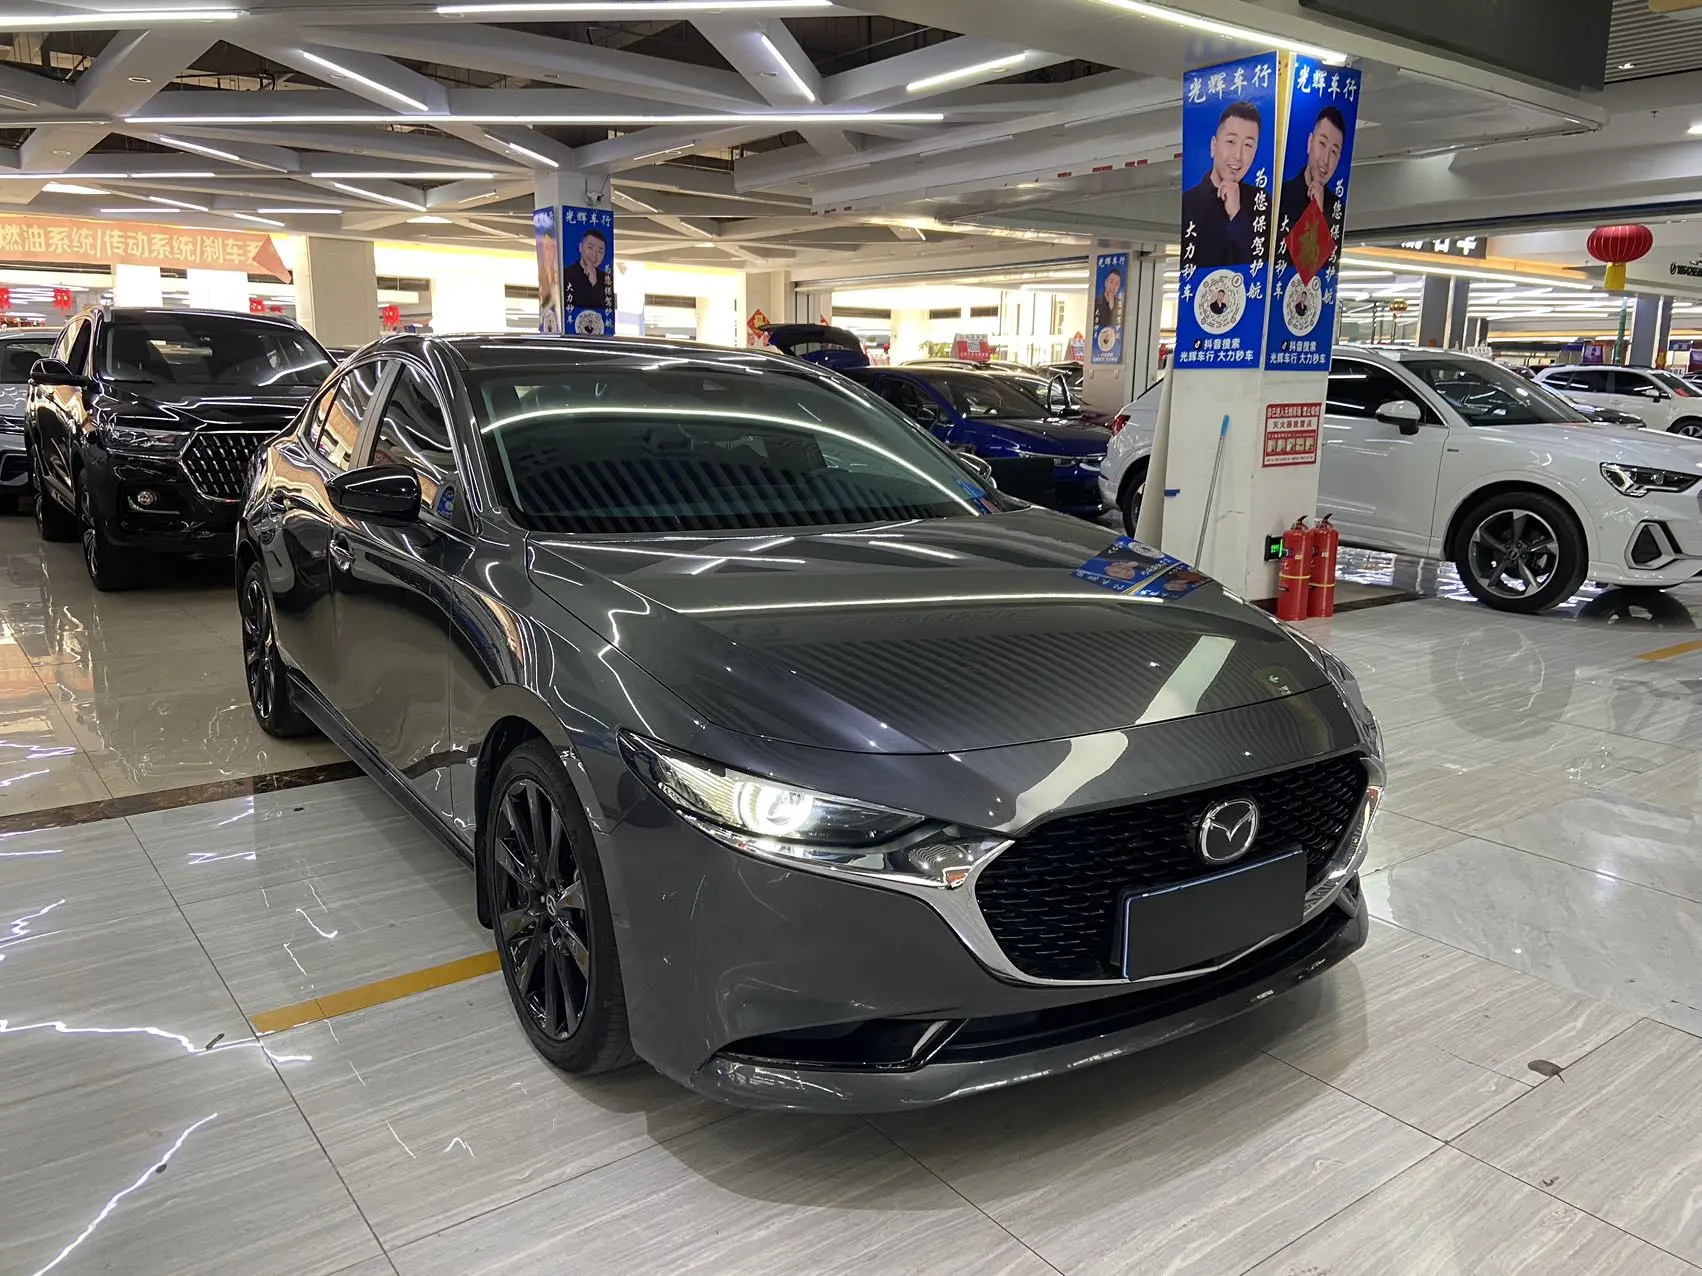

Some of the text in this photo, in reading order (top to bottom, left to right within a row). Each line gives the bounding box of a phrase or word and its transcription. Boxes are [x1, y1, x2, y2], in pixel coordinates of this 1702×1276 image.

[1188, 63, 1272, 103] 光辉车行
[1297, 64, 1357, 102] 光辉车行
[1246, 167, 1268, 300] 为您保驾护航
[1181, 221, 1197, 303] 大力秒车
[1204, 338, 1241, 350] 抖音搜索
[1217, 349, 1254, 362] 大力秒车
